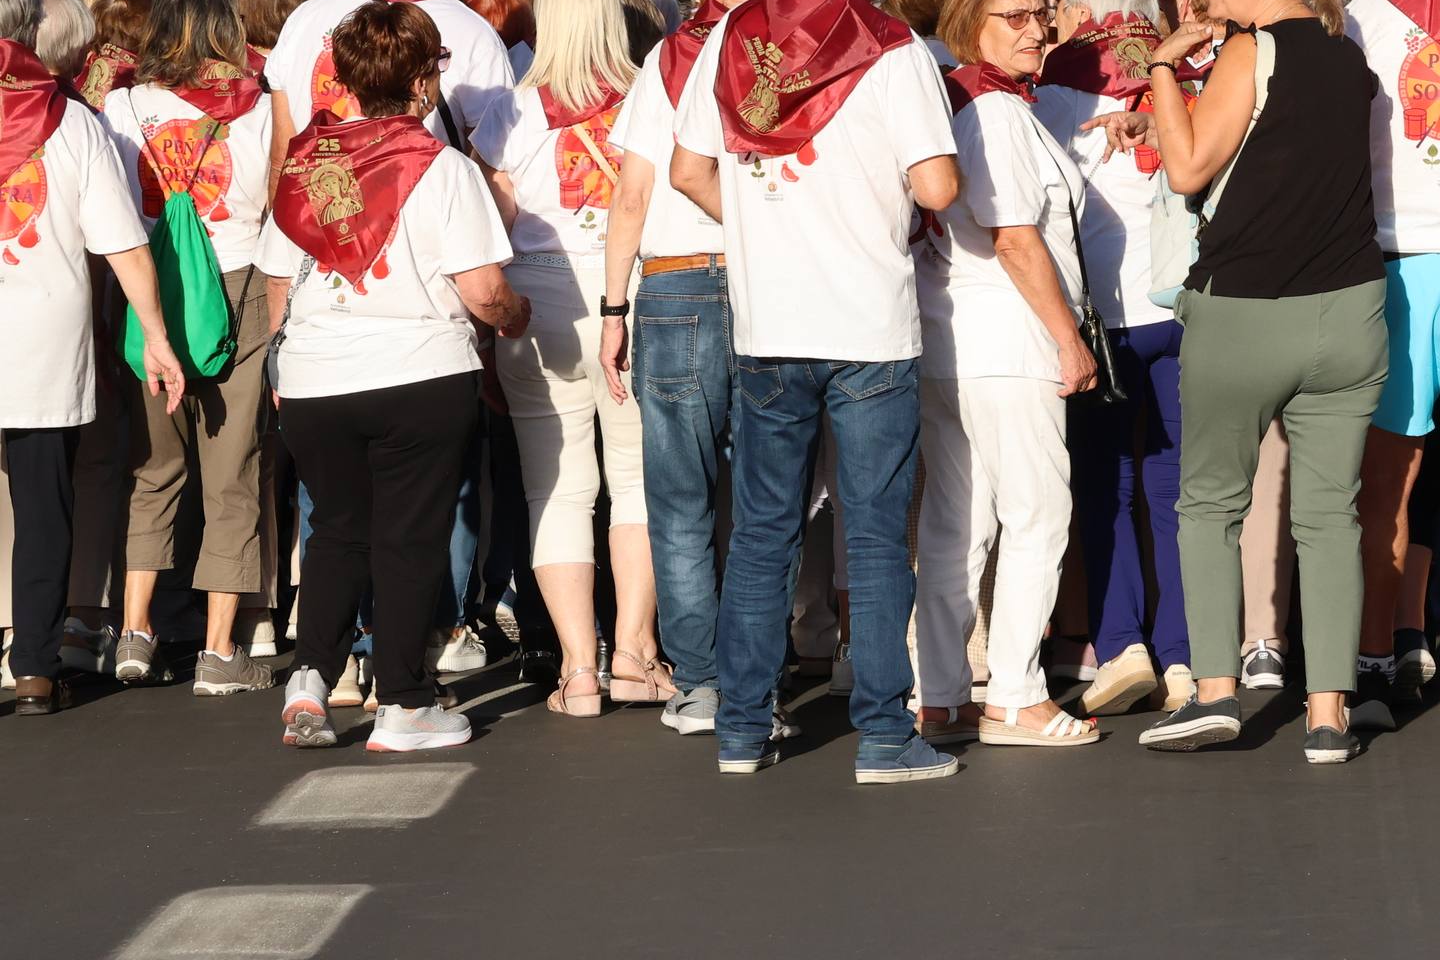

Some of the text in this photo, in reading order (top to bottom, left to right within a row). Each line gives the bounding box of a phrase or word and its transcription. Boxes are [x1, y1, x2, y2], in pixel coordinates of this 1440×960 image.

[765, 42, 784, 64] 25
[797, 70, 809, 80] LA
[318, 138, 341, 151] 25
